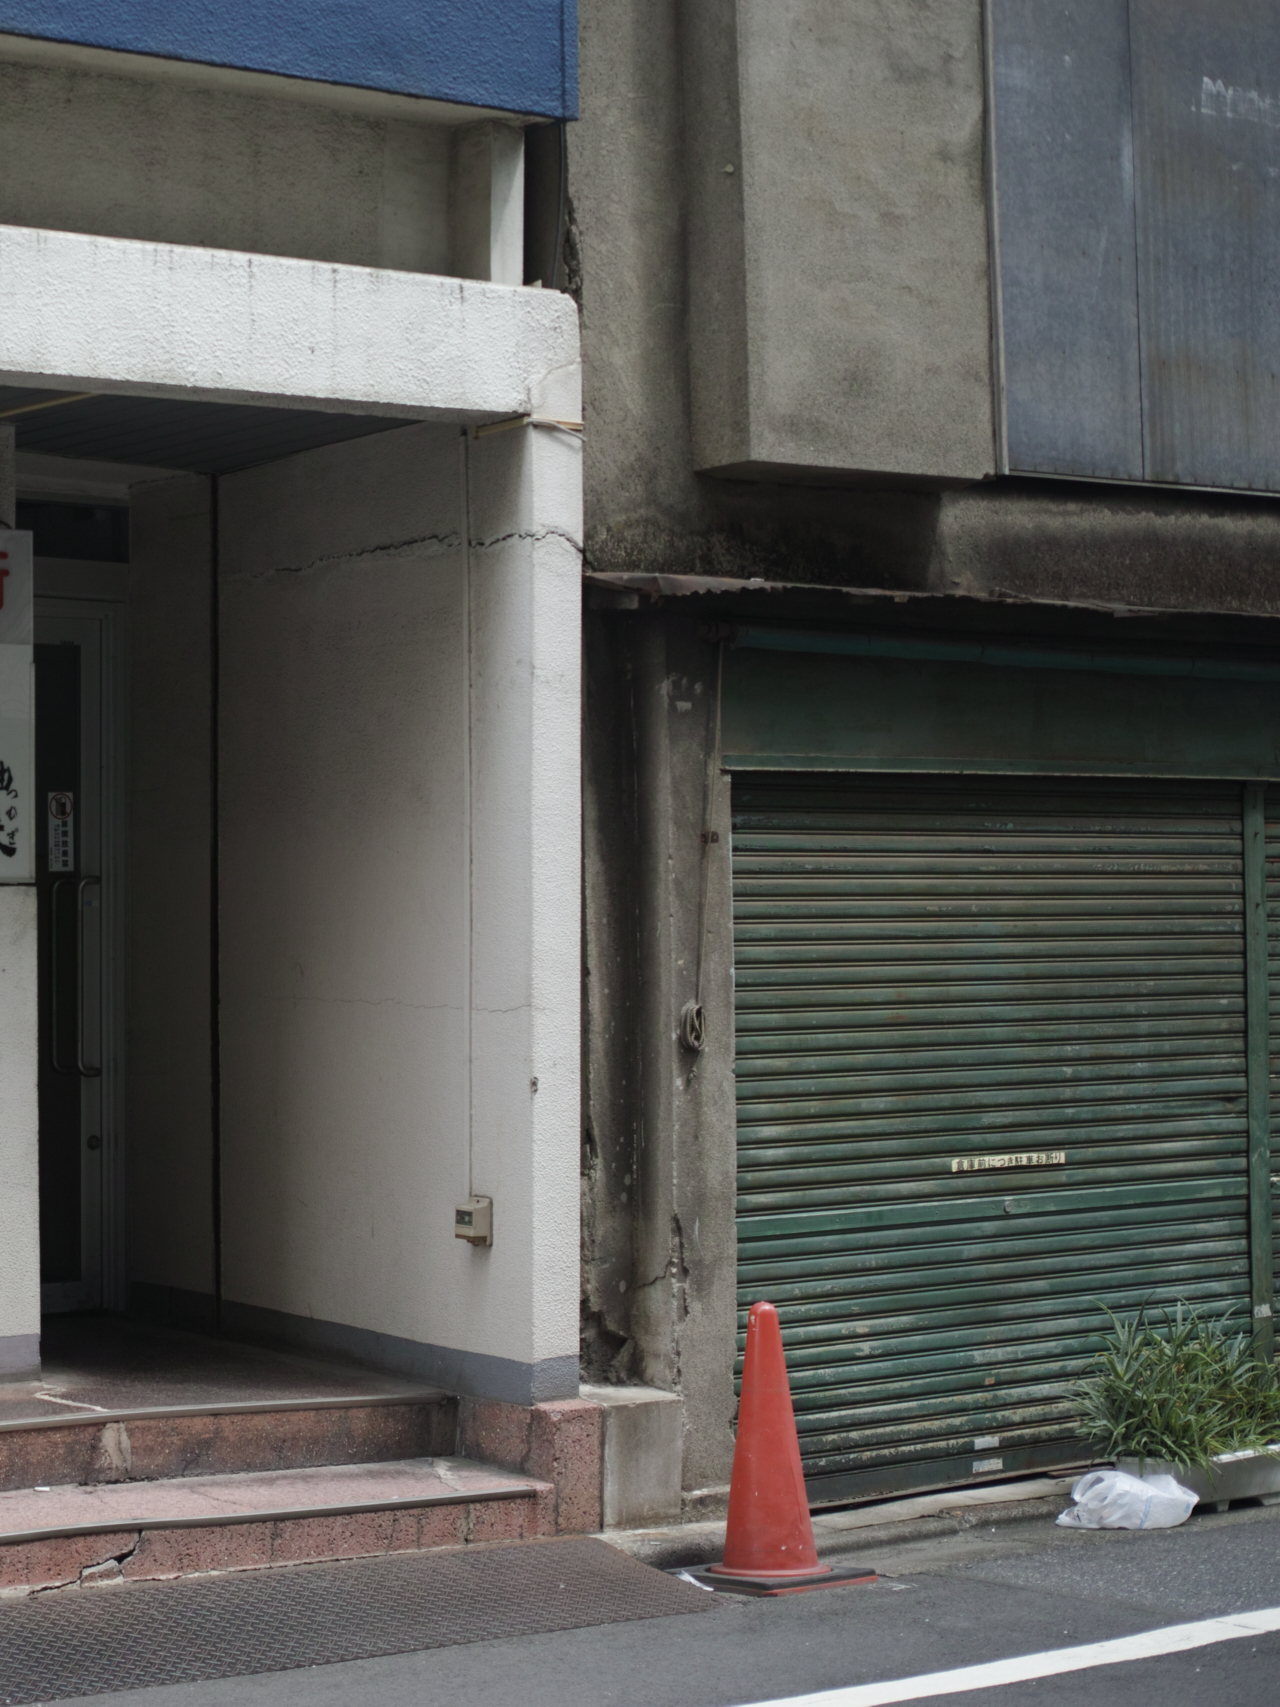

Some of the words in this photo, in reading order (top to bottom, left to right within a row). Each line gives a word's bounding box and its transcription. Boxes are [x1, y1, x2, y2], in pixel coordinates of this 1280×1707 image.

[956, 1152, 1062, 1171] 倉庫前につき駐車お断り
